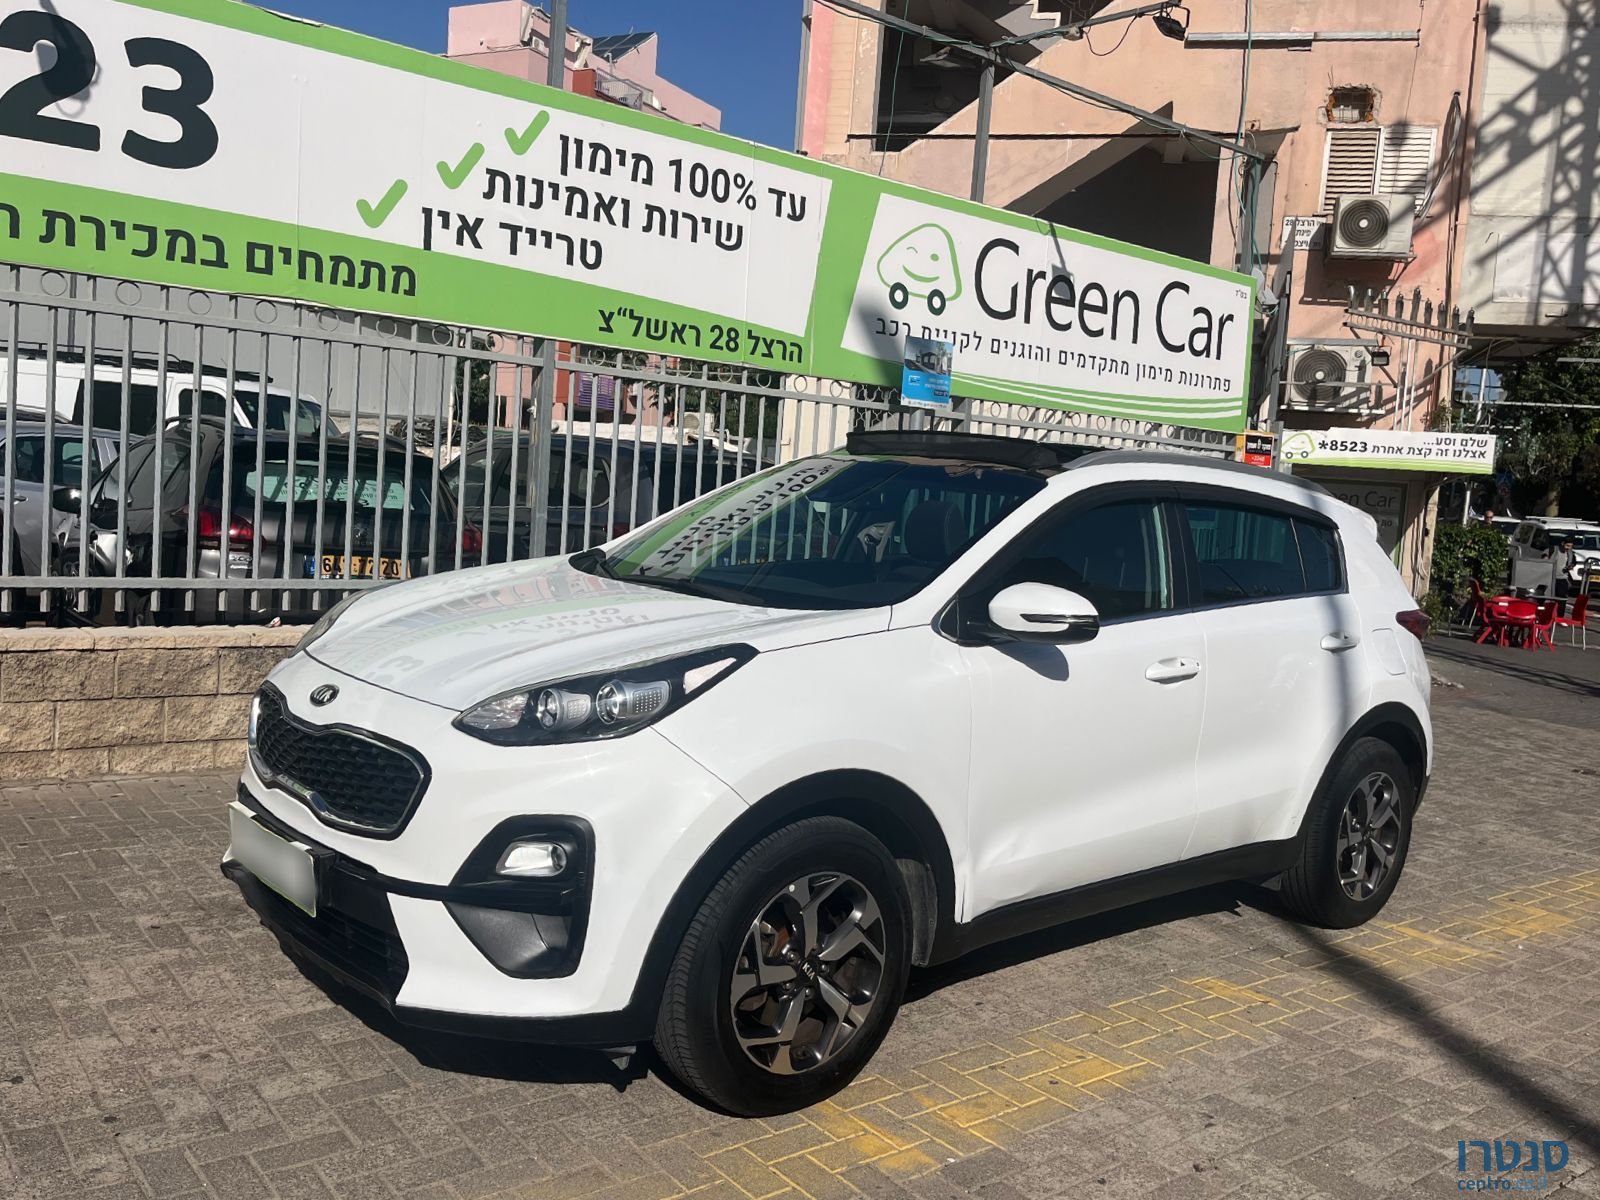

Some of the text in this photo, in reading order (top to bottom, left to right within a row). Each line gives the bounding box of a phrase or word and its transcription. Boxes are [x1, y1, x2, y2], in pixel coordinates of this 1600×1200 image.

[560, 135, 807, 222] עד 100% מימון
[483, 168, 743, 251] שירות ואמינות
[39, 209, 229, 269] במכירת
[422, 207, 603, 270] טרייד אין
[247, 242, 416, 297] מתמחים
[975, 238, 1235, 360] Green Car
[709, 325, 740, 353] 28
[747, 329, 803, 363] הרצל
[991, 338, 1051, 363] והוגנים
[1058, 350, 1130, 376] מתקדמים
[1135, 363, 1173, 382] מימון
[1178, 370, 1231, 393] פתרונות
[1371, 444, 1404, 455] אחרת
[1406, 446, 1432, 458] קצת
[1436, 448, 1450, 457] זה
[1453, 447, 1487, 459] אצלנו
[1461, 437, 1488, 448] שלם
